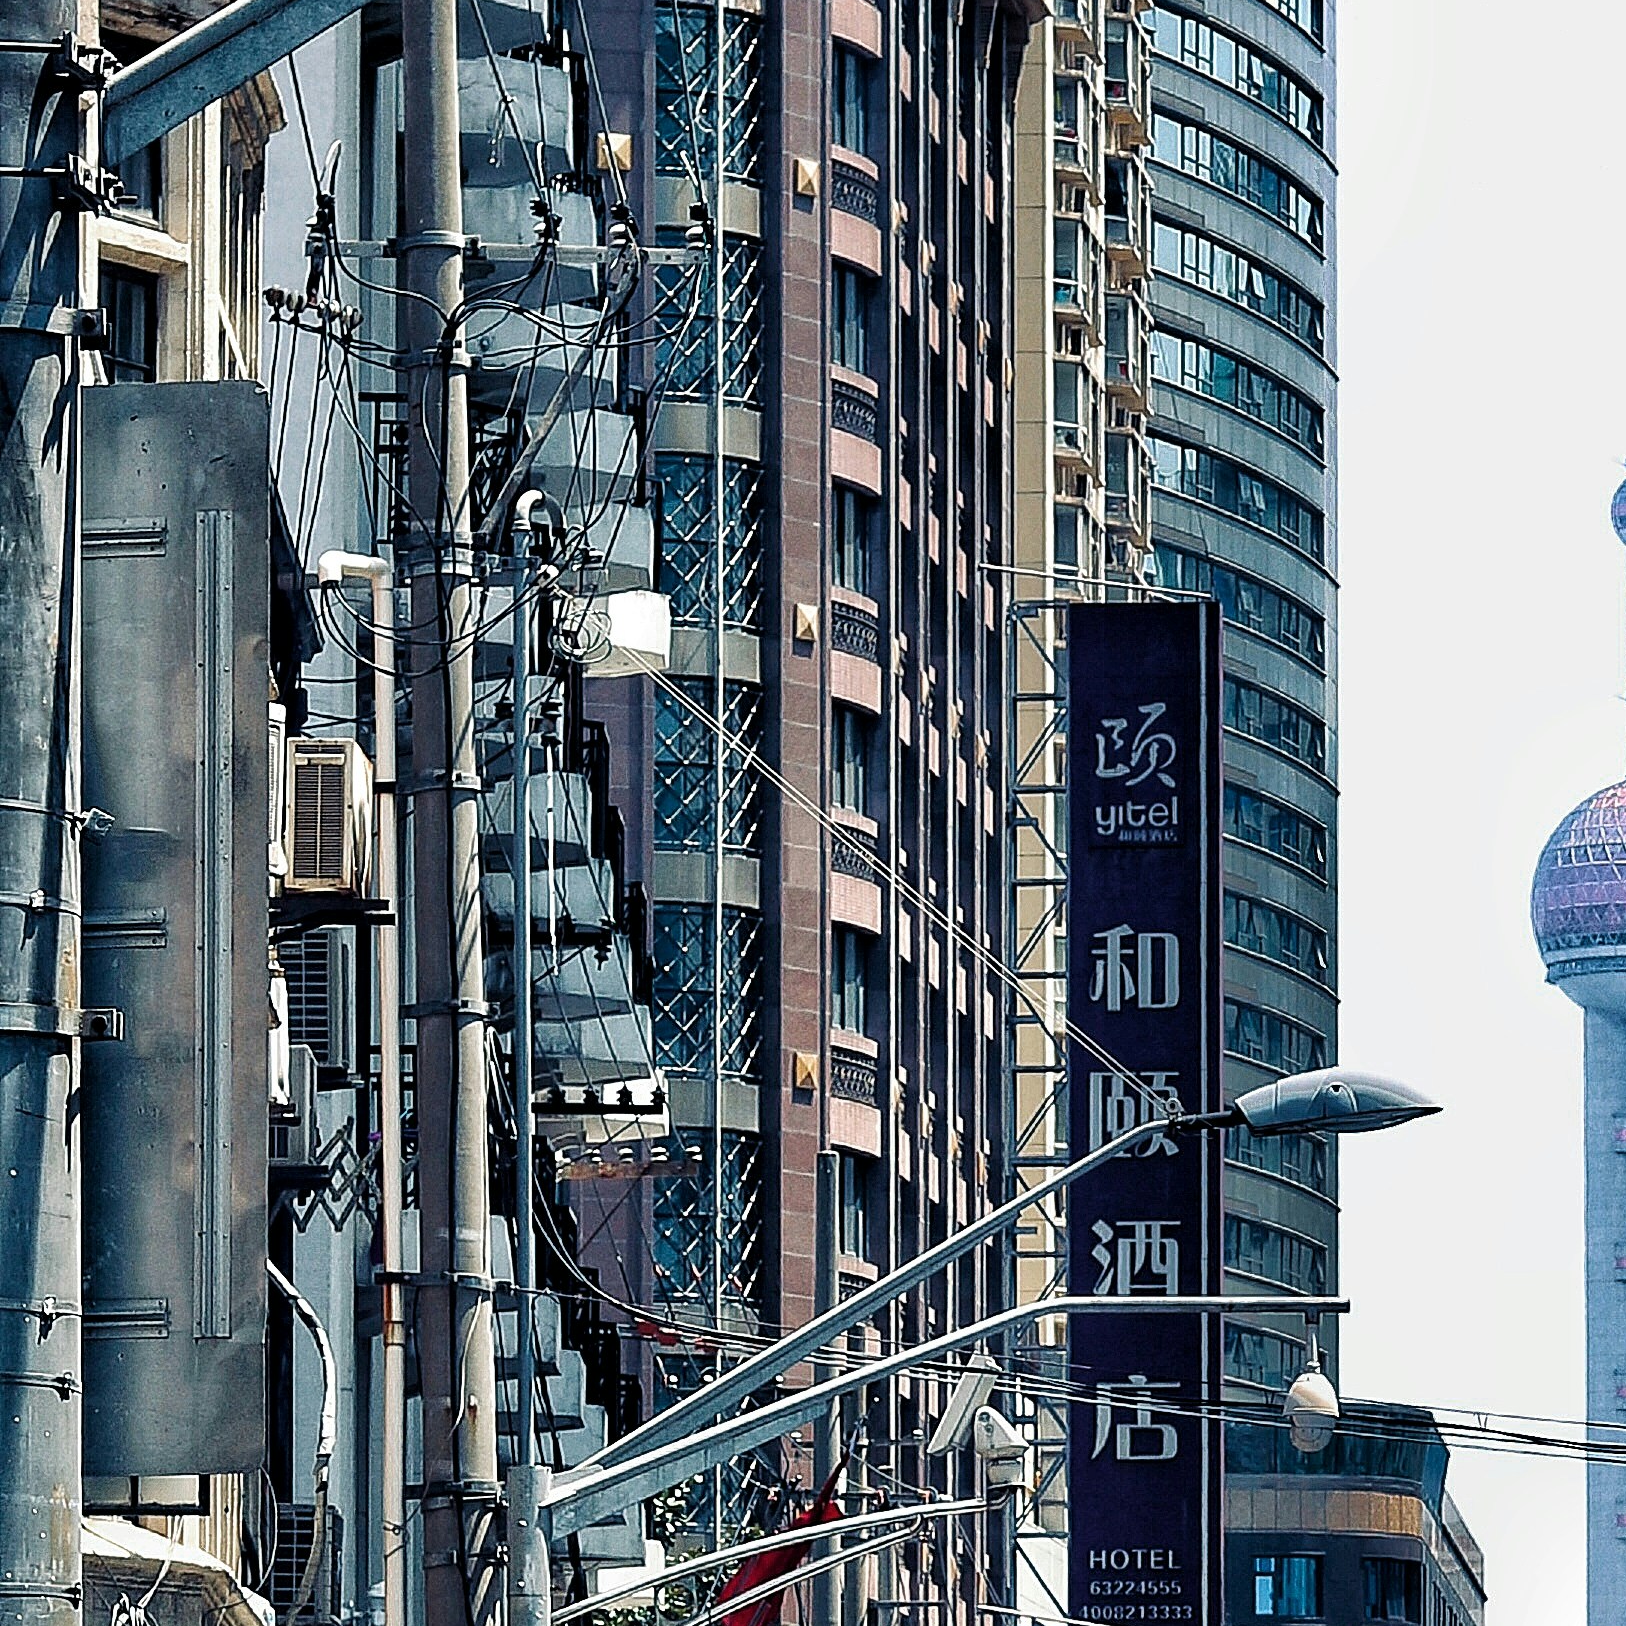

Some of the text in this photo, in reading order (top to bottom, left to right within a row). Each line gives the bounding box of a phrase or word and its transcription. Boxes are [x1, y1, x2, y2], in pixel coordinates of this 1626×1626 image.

[1095, 796, 1178, 835] yitel
[1088, 923, 1182, 1461] 和颐酒店
[1089, 1548, 1181, 1570] HOTEL
[1089, 1580, 1182, 1595] 63224555
[1079, 1605, 1192, 1620] 4008213333
